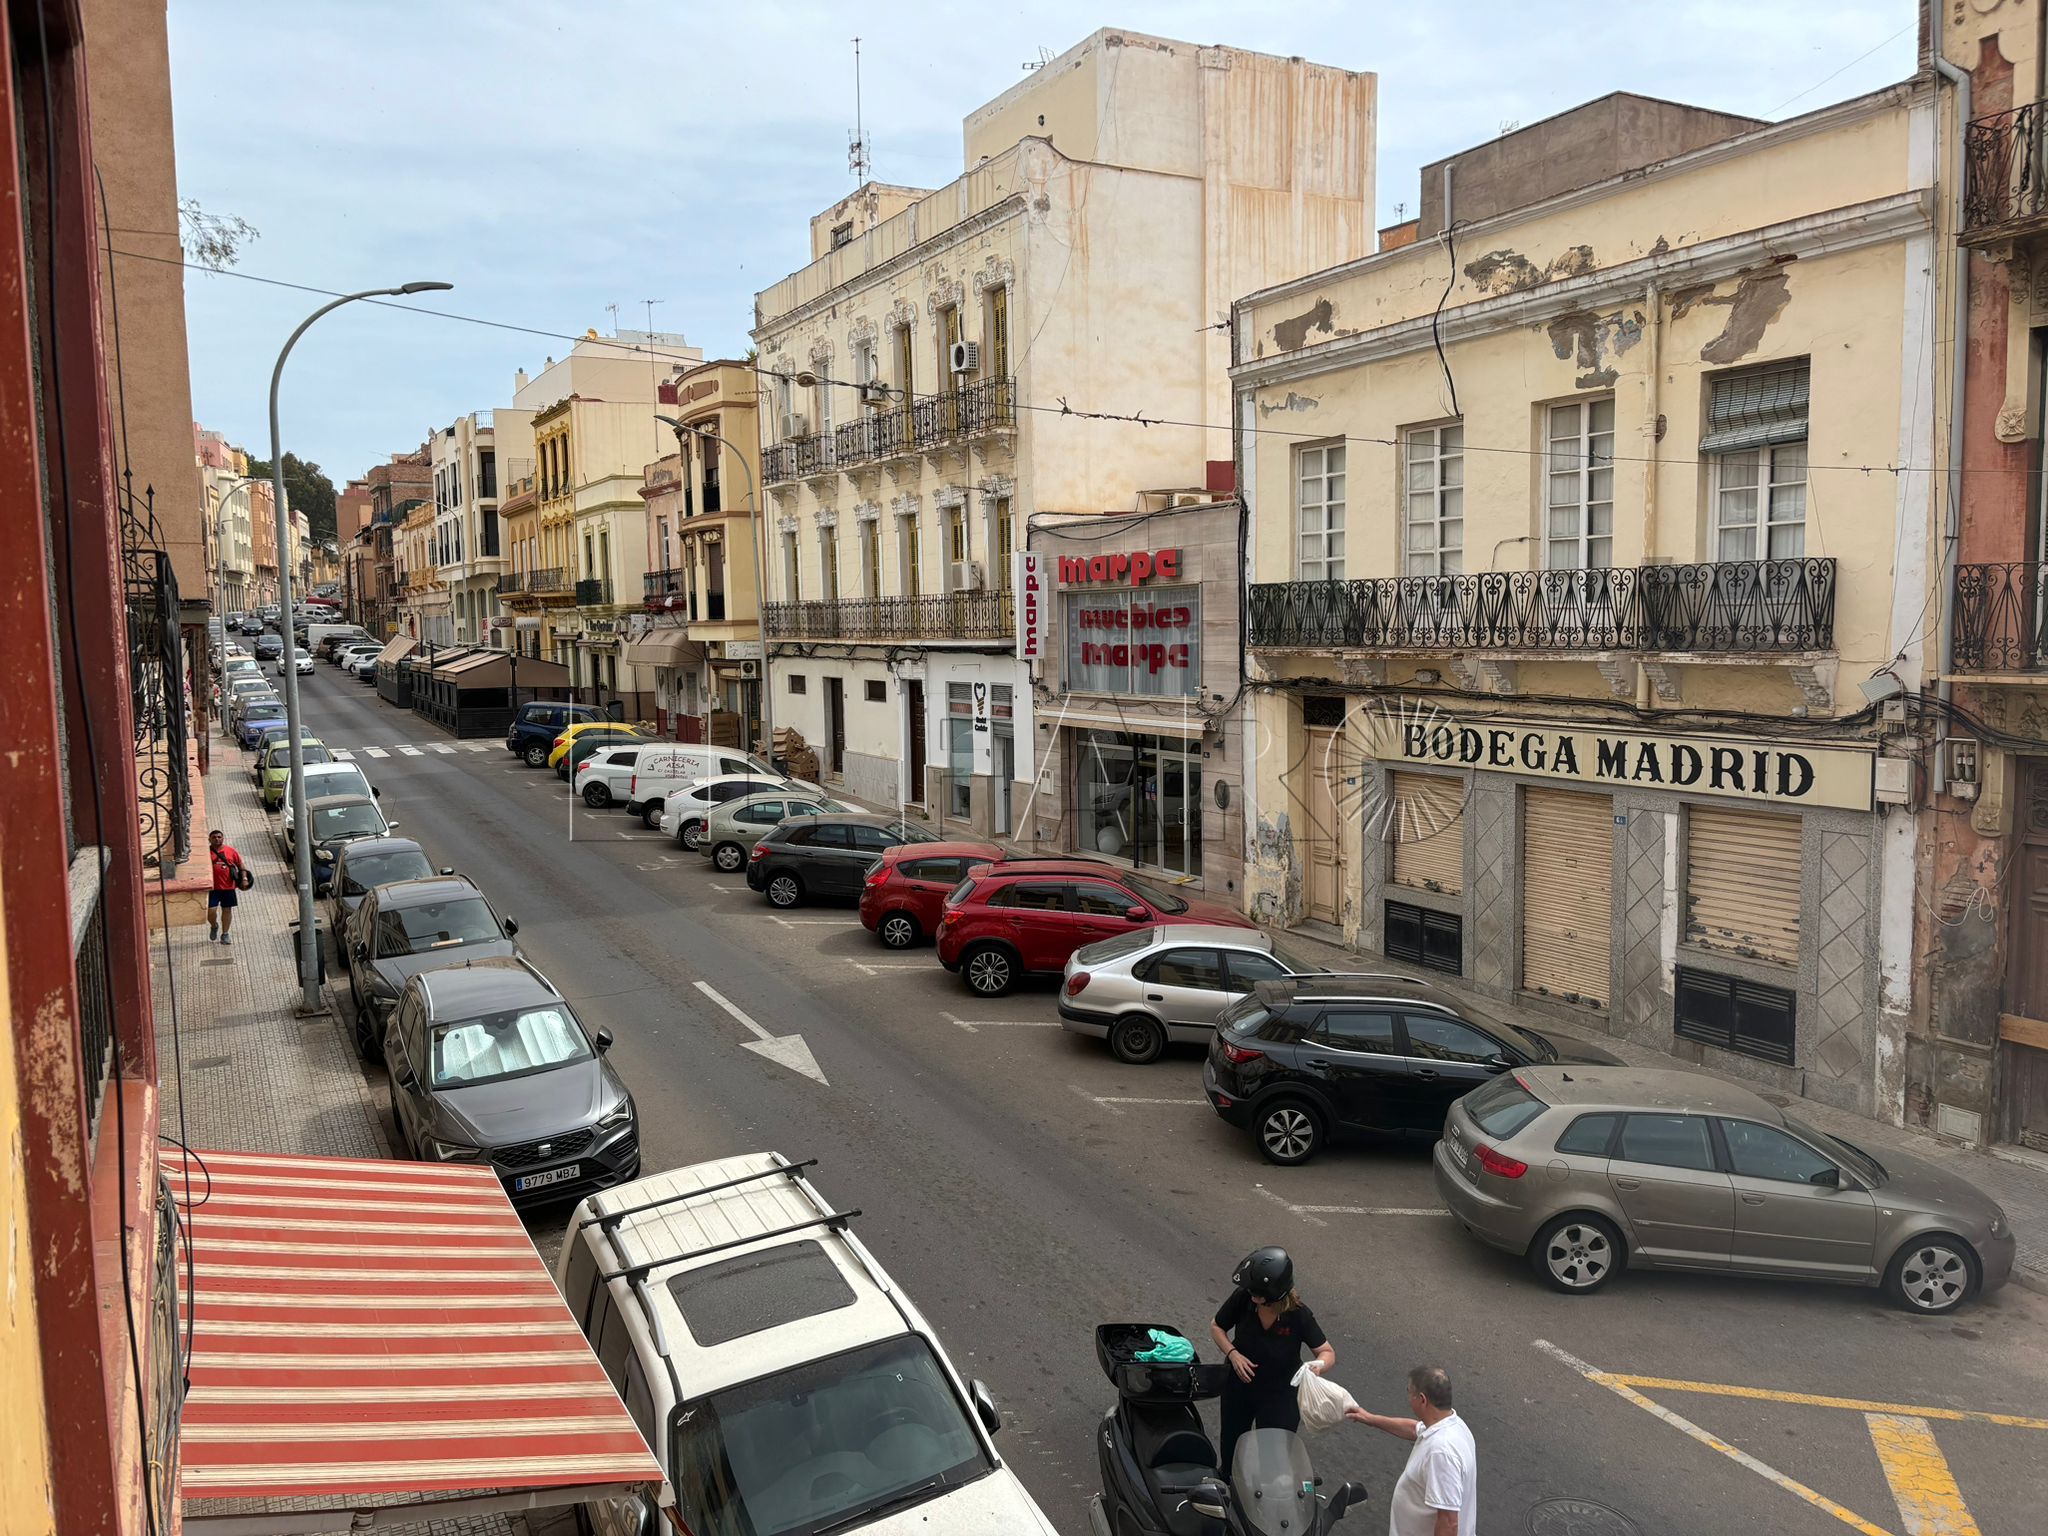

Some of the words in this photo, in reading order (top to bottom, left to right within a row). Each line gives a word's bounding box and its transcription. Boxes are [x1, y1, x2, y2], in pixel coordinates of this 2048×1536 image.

[653, 756, 700, 768] CARNICERIA
[1403, 723, 1580, 774] BODEGA
[1596, 737, 1816, 797] MADRID
[524, 1173, 553, 1188] 9779
[556, 1167, 577, 1181] MBZ
